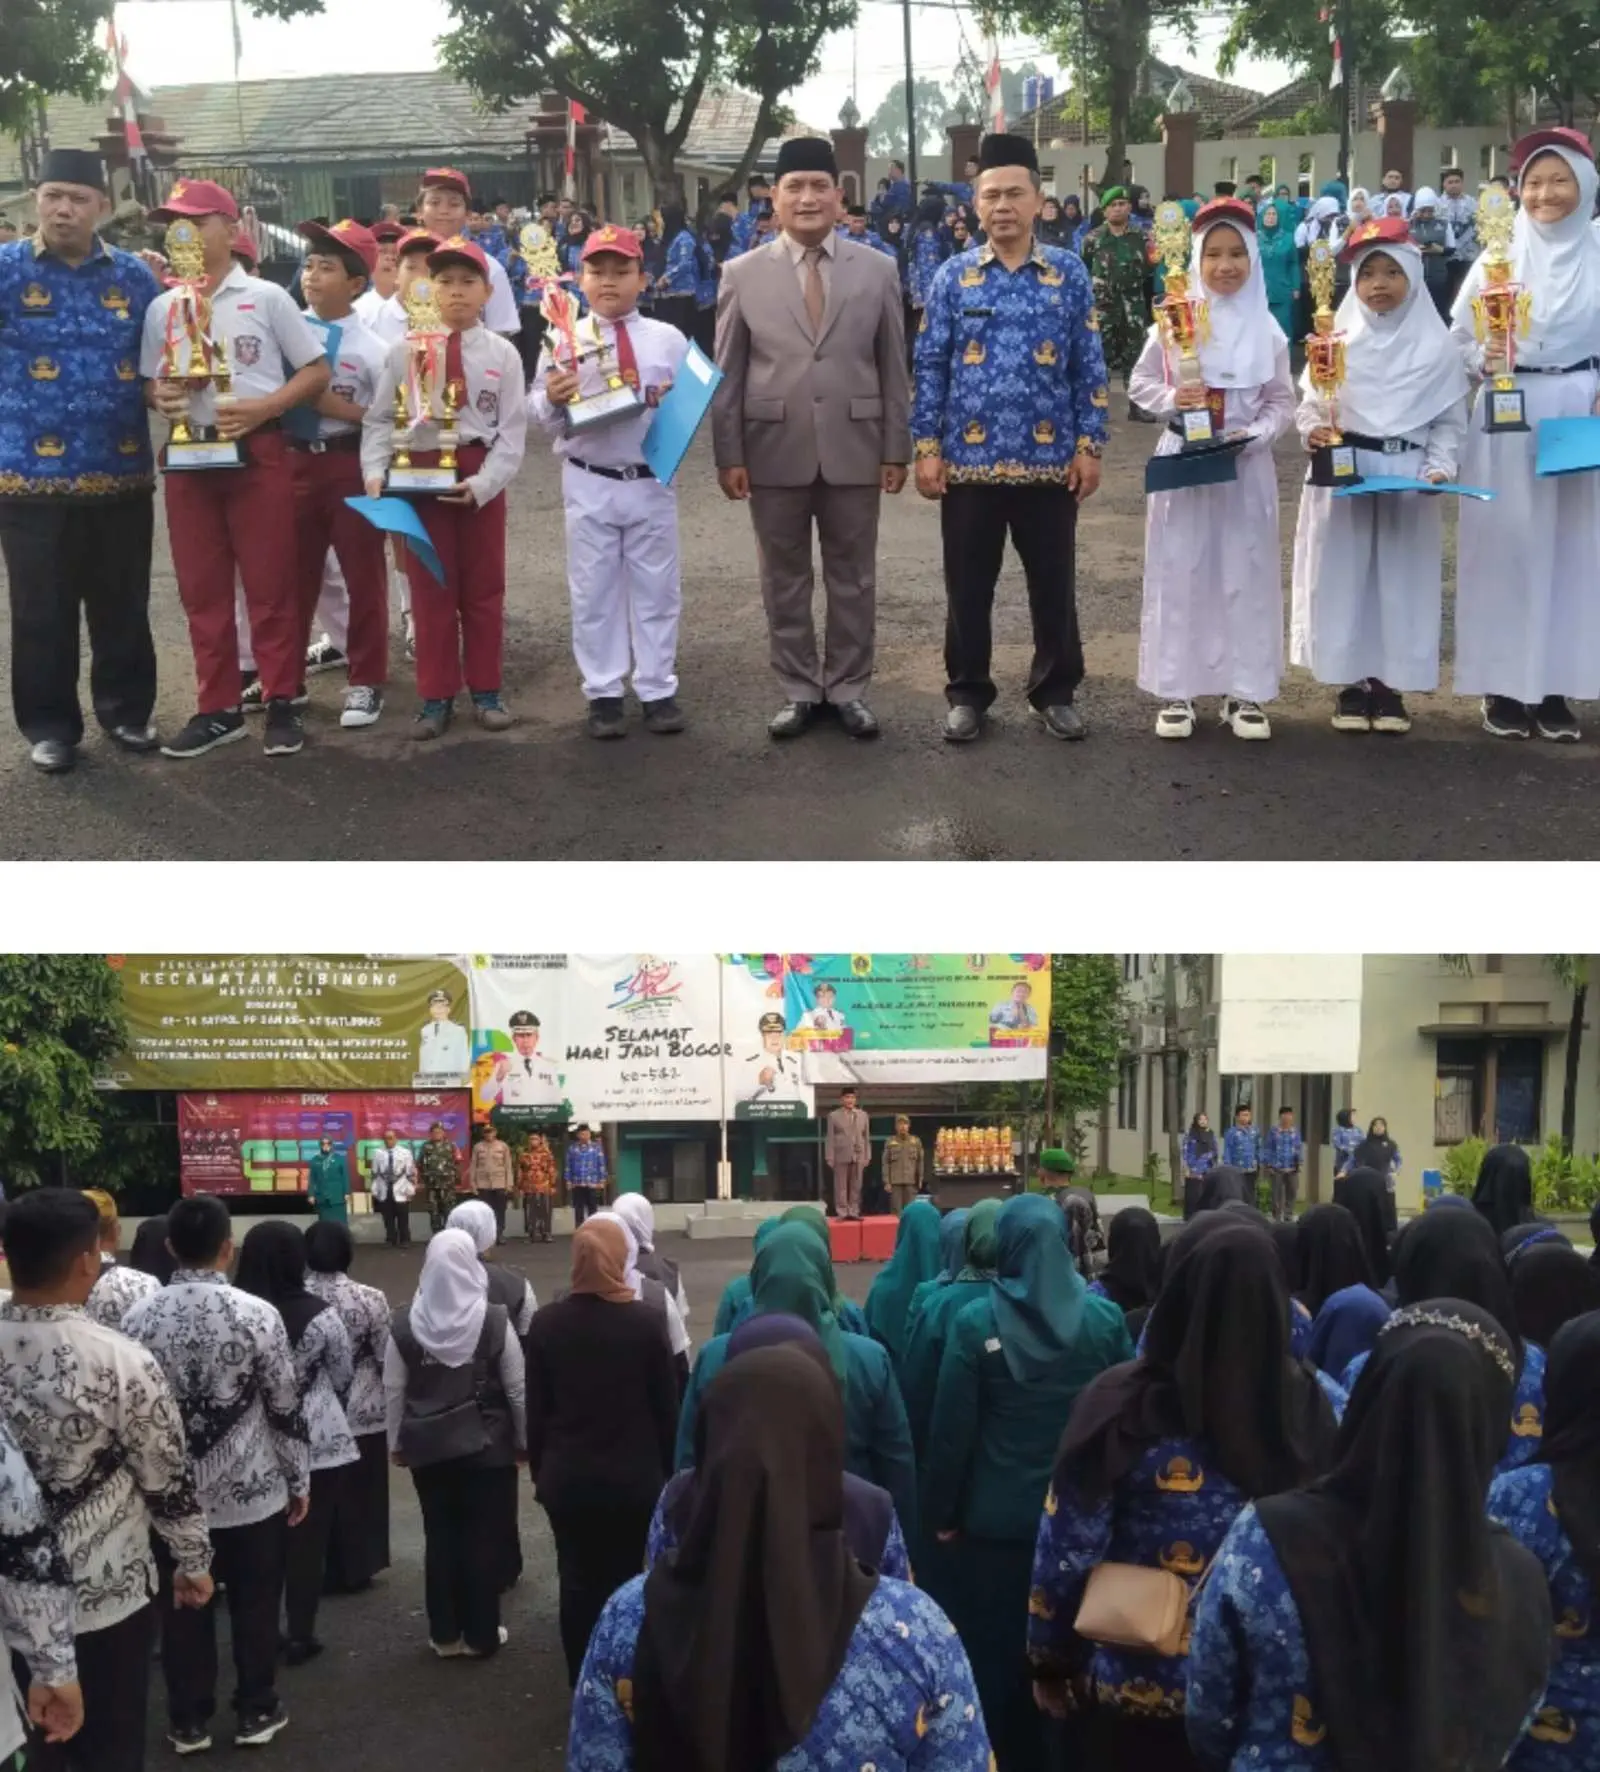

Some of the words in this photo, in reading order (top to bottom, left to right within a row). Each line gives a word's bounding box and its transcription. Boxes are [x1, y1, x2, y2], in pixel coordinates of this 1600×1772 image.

[140, 971, 277, 986] KECAMATAN
[294, 971, 397, 986] CIBINONG
[604, 1026, 694, 1043] SELAMAT
[566, 1045, 609, 1061] HARI
[617, 1043, 660, 1060] JADI
[667, 1041, 733, 1058] BOGOR
[301, 1093, 329, 1106] PPK
[414, 1093, 441, 1106] PPS
